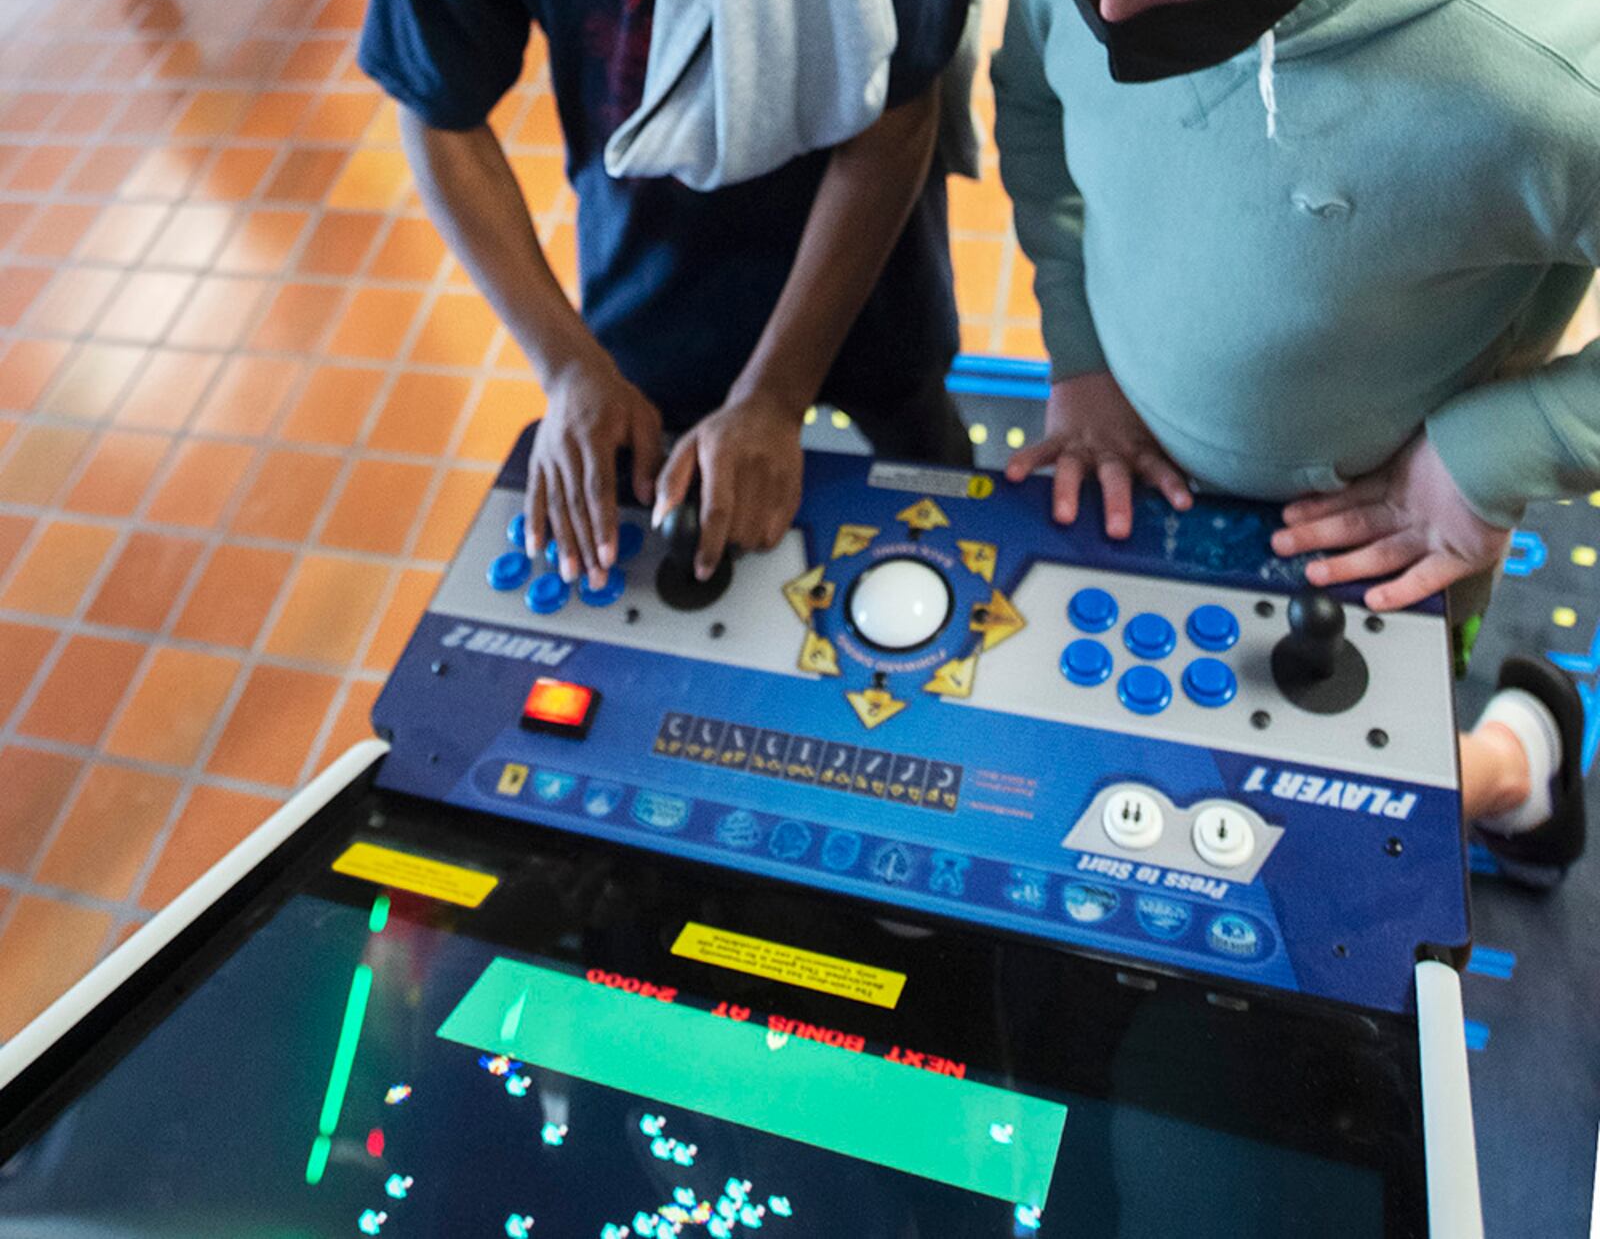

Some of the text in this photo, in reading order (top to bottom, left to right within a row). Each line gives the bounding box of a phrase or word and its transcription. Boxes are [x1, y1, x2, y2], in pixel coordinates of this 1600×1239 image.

[441, 624, 573, 667] PLAYER 2
[1243, 766, 1417, 821] PLAYER 1
[1076, 854, 1229, 900] Press to Start
[585, 968, 967, 1080] NEXT BONUS AT 24000
